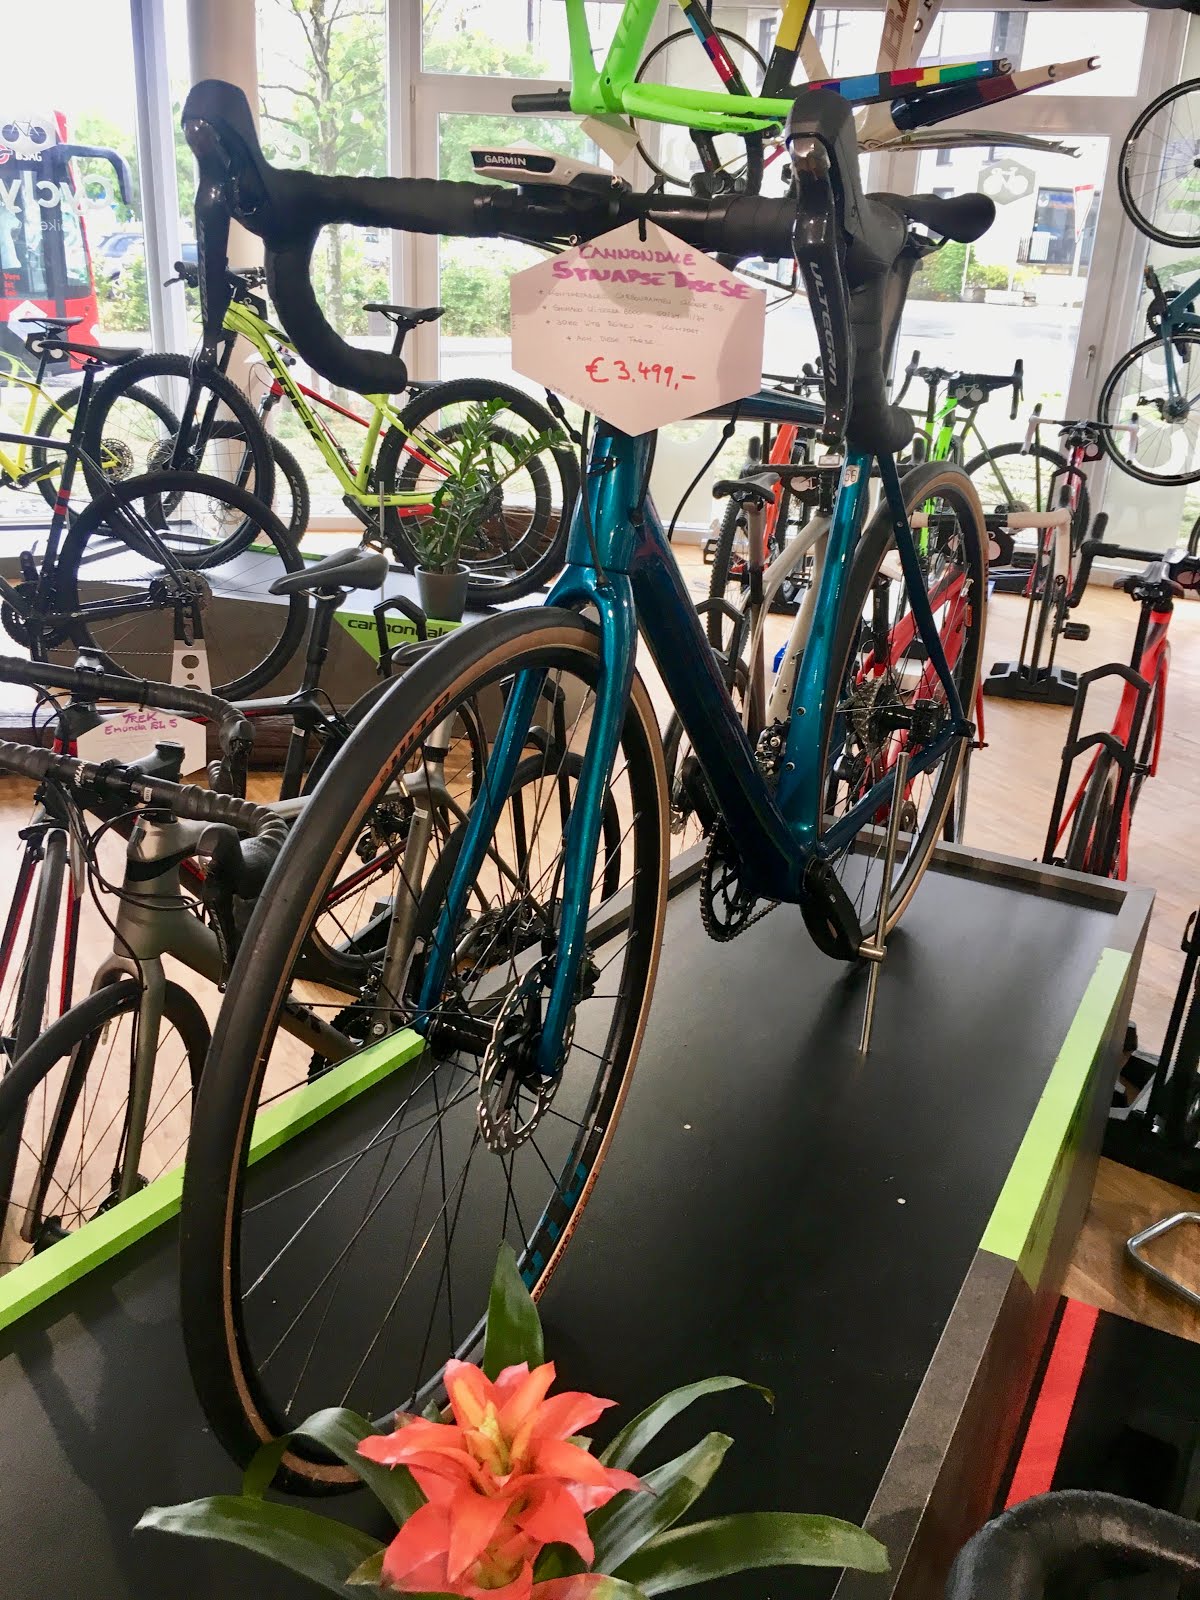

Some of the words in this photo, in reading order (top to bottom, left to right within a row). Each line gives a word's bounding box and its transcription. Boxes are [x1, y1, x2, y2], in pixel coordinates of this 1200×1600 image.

[484, 155, 527, 166] GARMIN
[578, 244, 697, 266] CANNONDALE
[809, 261, 838, 387] ULTEGRA
[585, 357, 609, 383] €
[290, 475, 302, 526] KENDA
[122, 711, 158, 724] TREK
